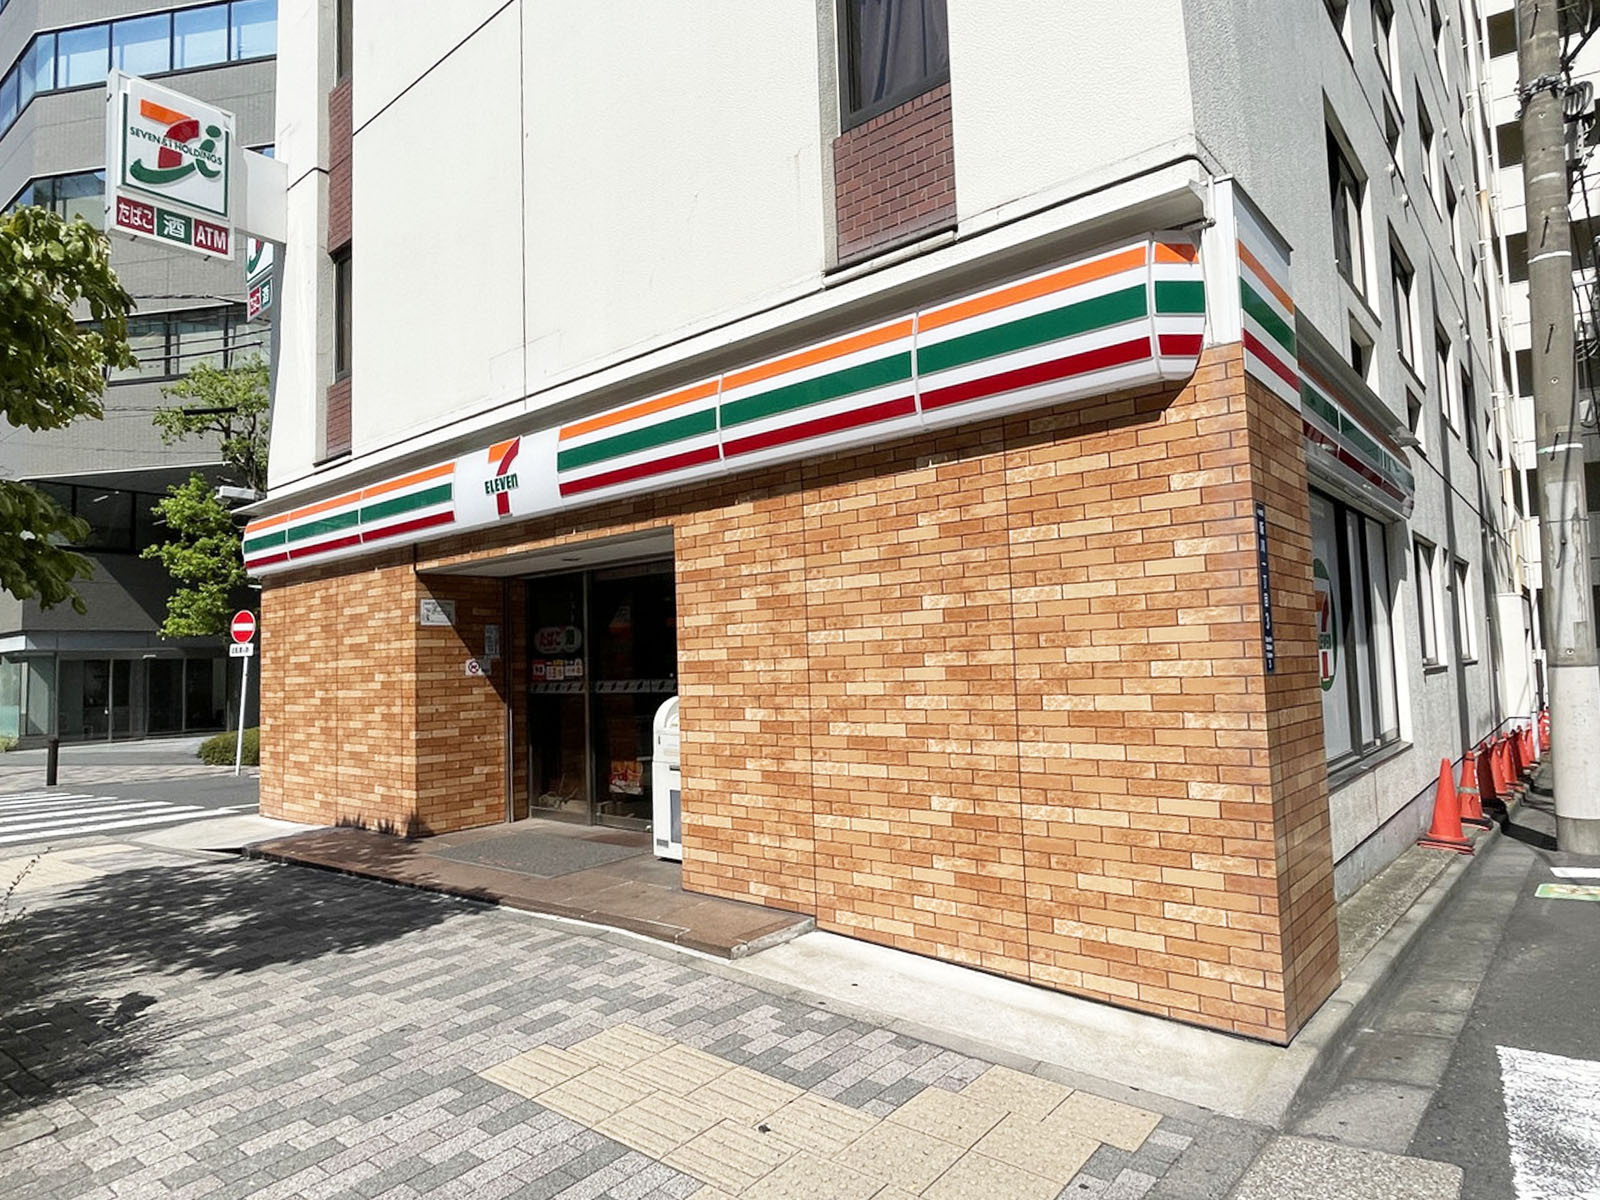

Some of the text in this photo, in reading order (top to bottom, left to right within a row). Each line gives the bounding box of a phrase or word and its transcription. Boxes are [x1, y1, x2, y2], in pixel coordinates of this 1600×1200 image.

[174, 143, 223, 166] HOLDINGS
[118, 203, 153, 229] たばこ
[163, 214, 186, 239] 酒
[195, 226, 227, 250] ATM
[488, 437, 521, 515] 7
